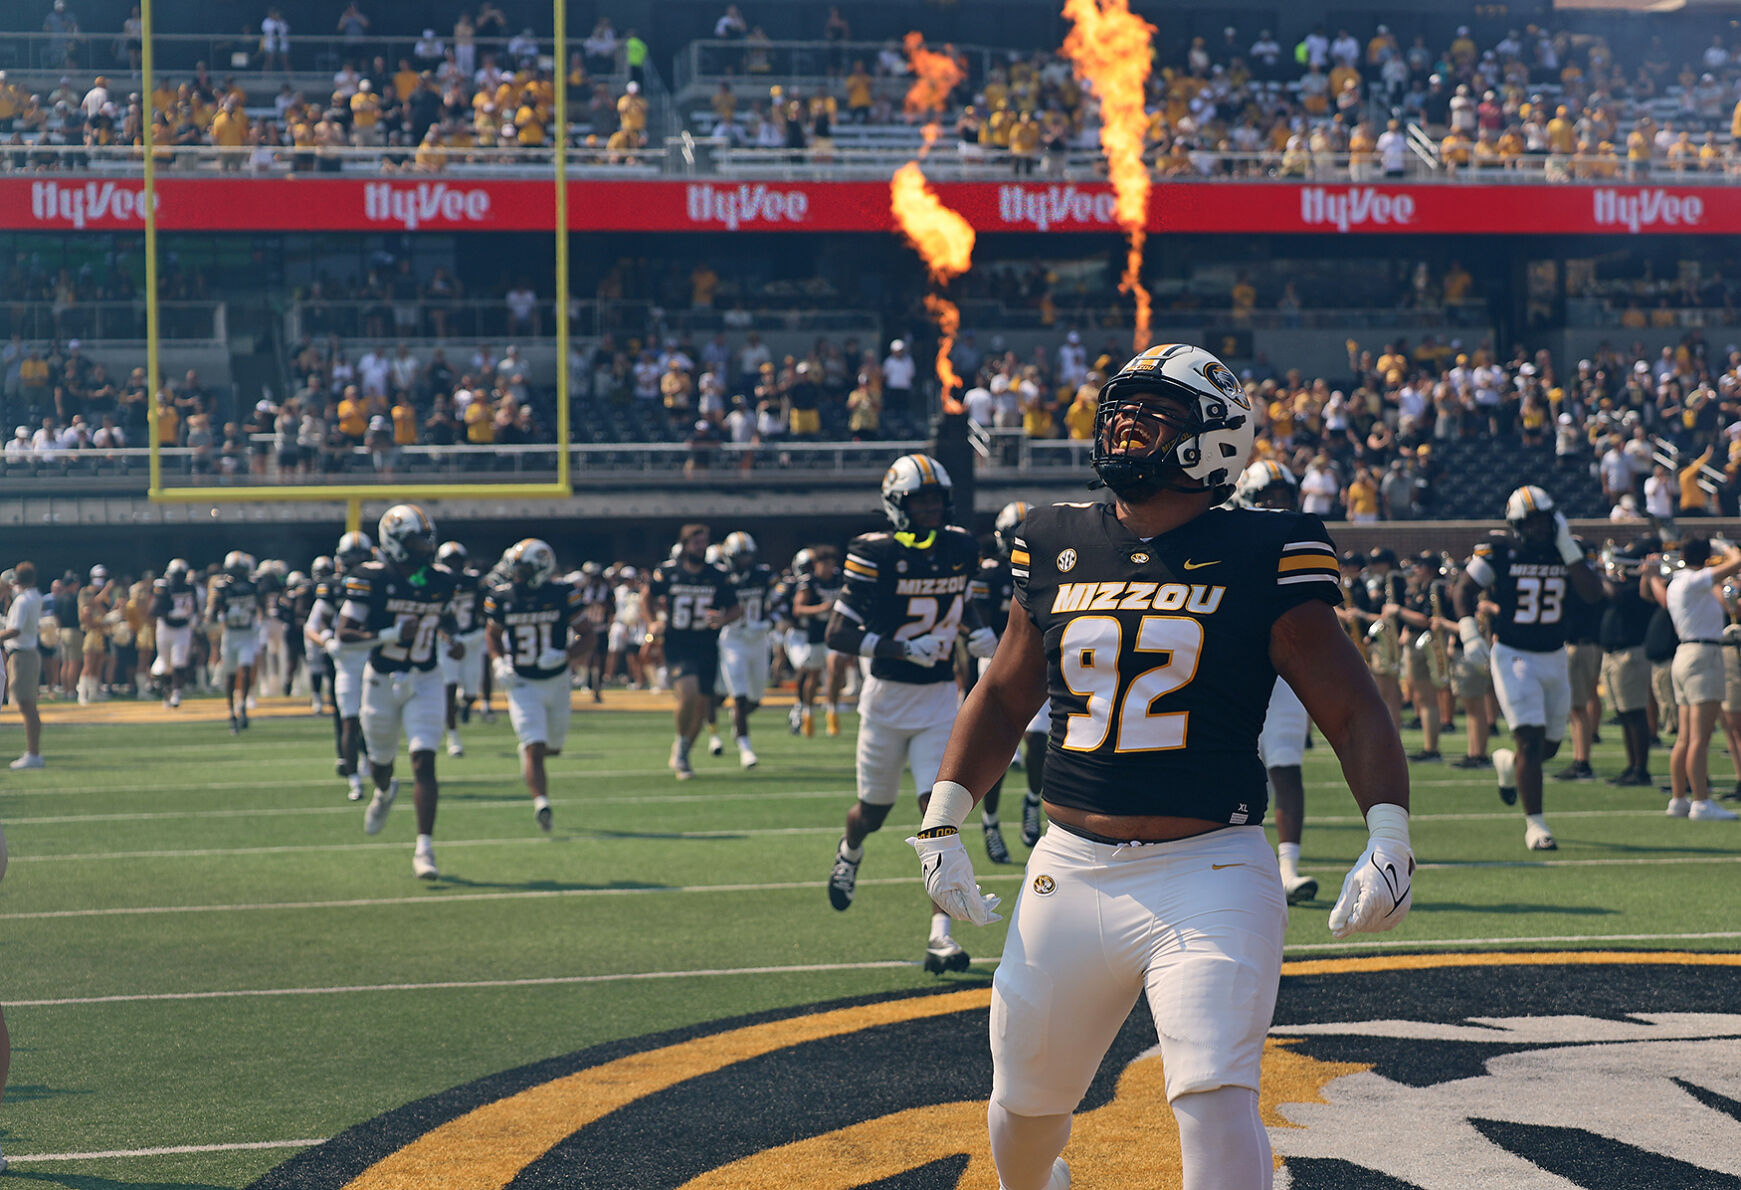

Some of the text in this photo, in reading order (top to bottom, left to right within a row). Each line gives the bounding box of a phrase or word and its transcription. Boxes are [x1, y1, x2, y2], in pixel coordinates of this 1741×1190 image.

[31, 181, 159, 228] HyVee
[364, 182, 489, 229] HyVee
[686, 184, 808, 230] HyVee
[998, 185, 1116, 231] HyVee
[1301, 187, 1415, 233] HyVee
[1593, 188, 1703, 234] HyVee
[672, 595, 715, 631] 65
[1050, 581, 1227, 615] MIZZOU
[1513, 577, 1567, 624] 33
[515, 623, 554, 667] 31
[893, 594, 963, 661] 24
[1060, 615, 1205, 754] 92
[1237, 803, 1249, 812] XL
